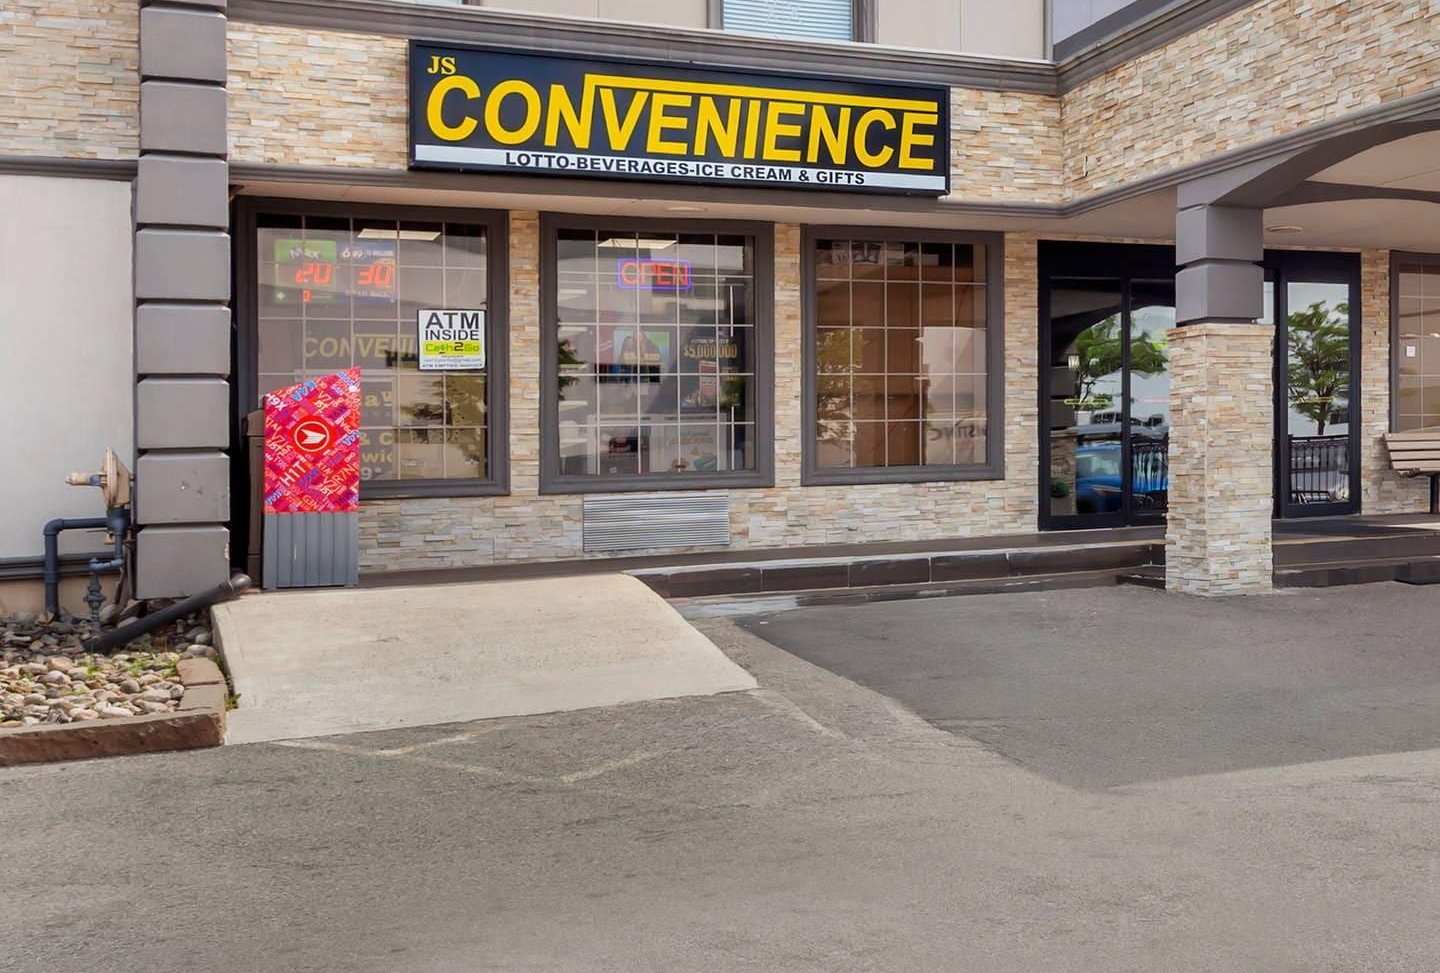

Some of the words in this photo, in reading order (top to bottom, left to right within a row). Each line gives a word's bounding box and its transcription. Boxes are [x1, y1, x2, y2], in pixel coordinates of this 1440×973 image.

[427, 55, 457, 76] JS
[426, 73, 939, 171] CONVENIENCE
[730, 165, 792, 182] CREAM
[798, 169, 810, 182] &
[816, 170, 865, 185] GIFTS
[622, 260, 689, 285] OPEN
[425, 312, 479, 329] ATM
[425, 330, 480, 341] INSIDE
[279, 460, 306, 487] H1T
